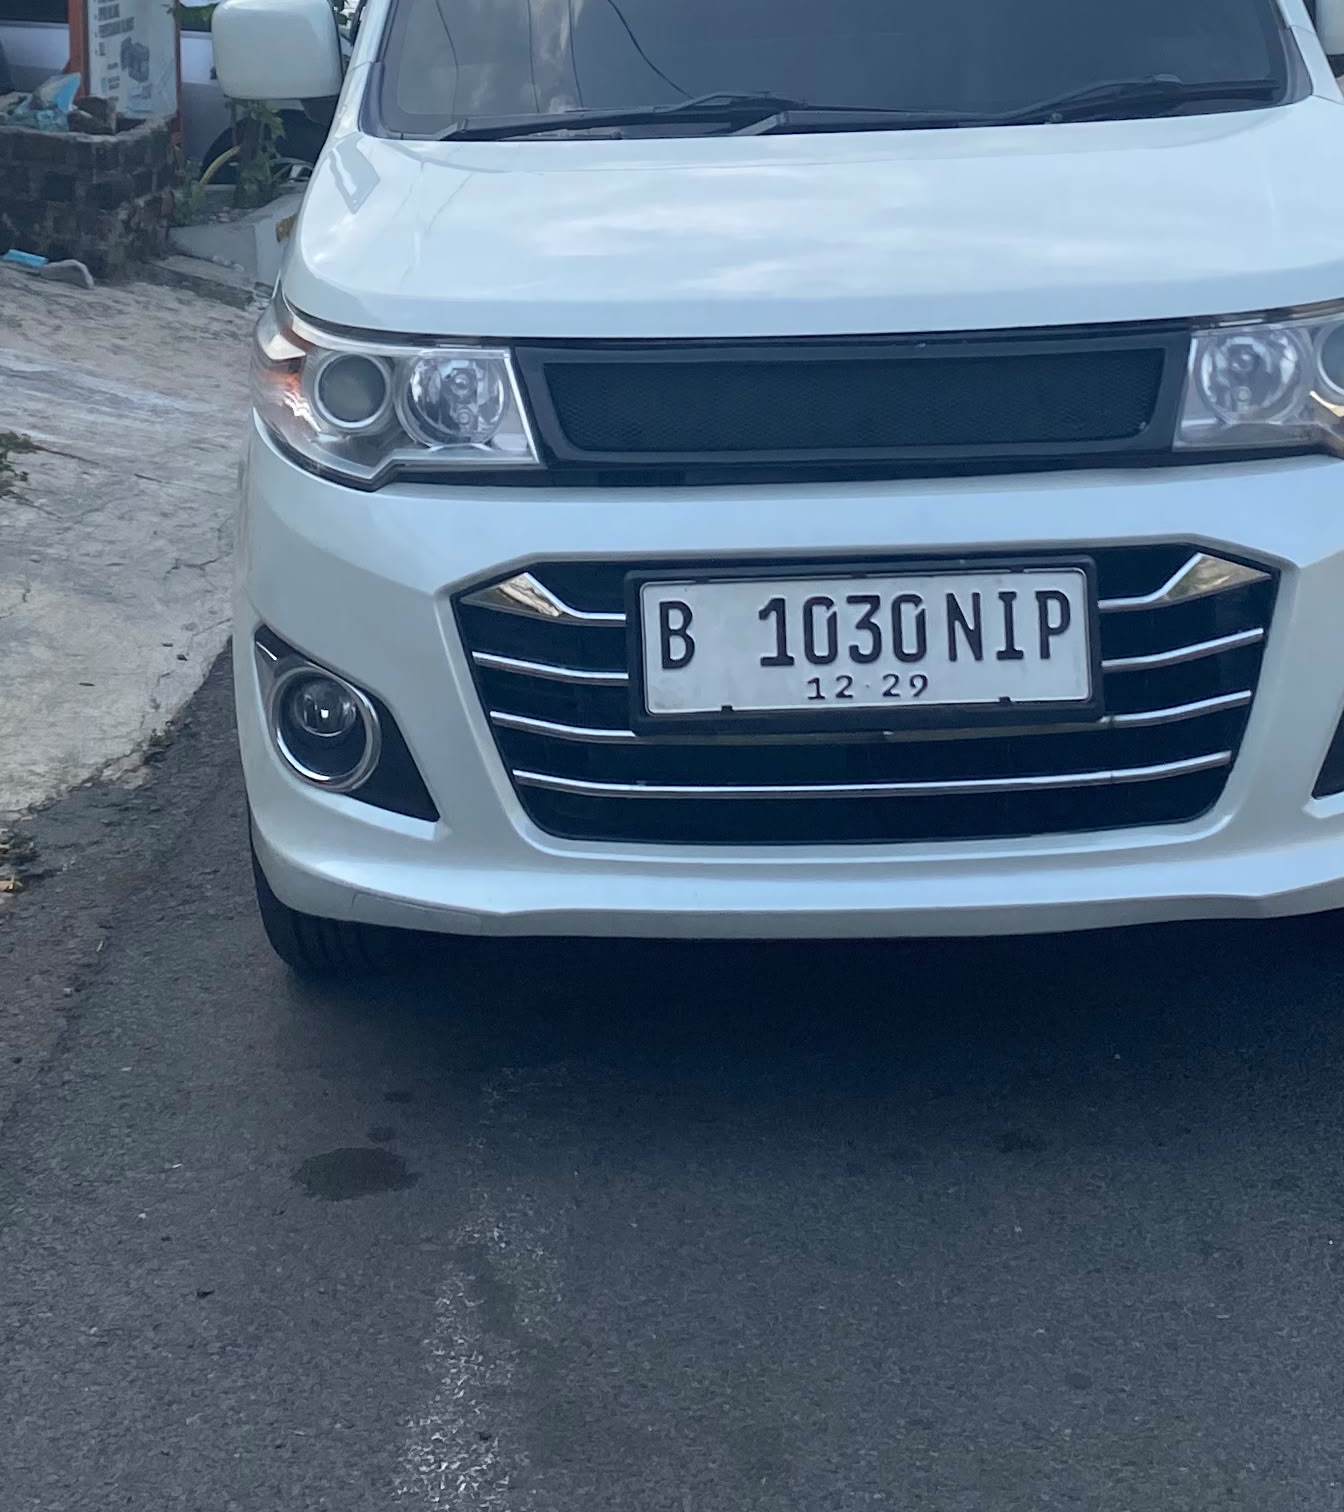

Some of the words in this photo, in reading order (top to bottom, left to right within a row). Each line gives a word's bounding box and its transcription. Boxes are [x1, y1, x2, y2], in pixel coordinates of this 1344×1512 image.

[659, 601, 695, 670] B
[758, 594, 928, 668] 1030
[946, 590, 1072, 663] NIP
